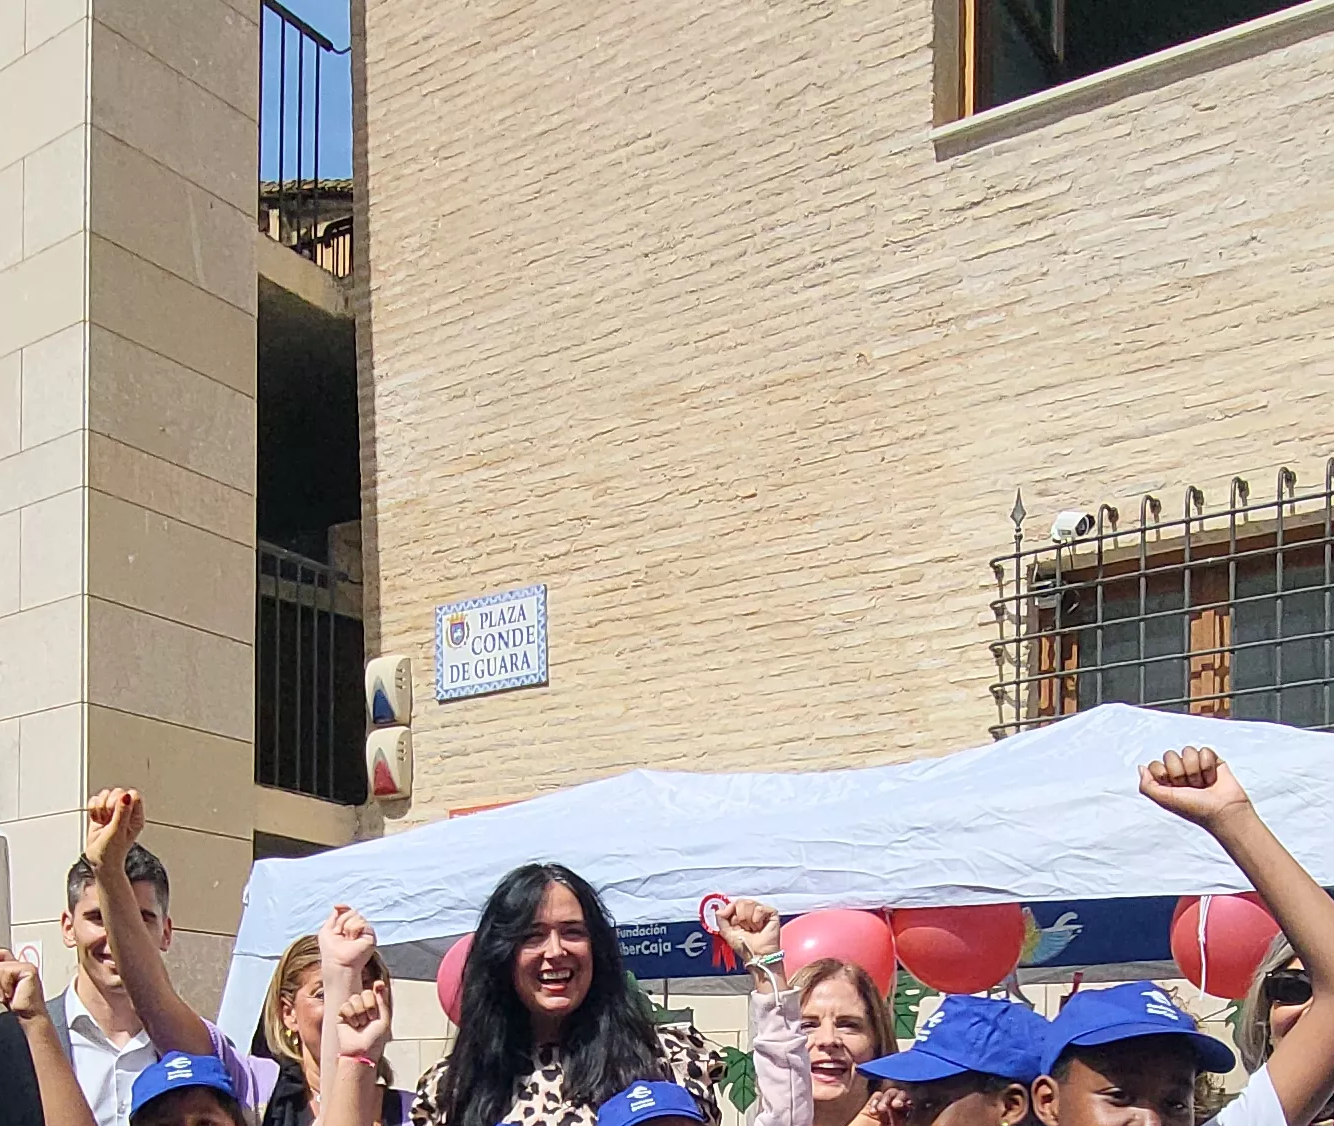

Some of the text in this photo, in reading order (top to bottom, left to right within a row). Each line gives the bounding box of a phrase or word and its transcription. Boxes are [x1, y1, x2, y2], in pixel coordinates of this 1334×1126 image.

[479, 603, 527, 630] PLAZA
[471, 624, 535, 655] CONDE
[449, 650, 531, 684] DE GUARA
